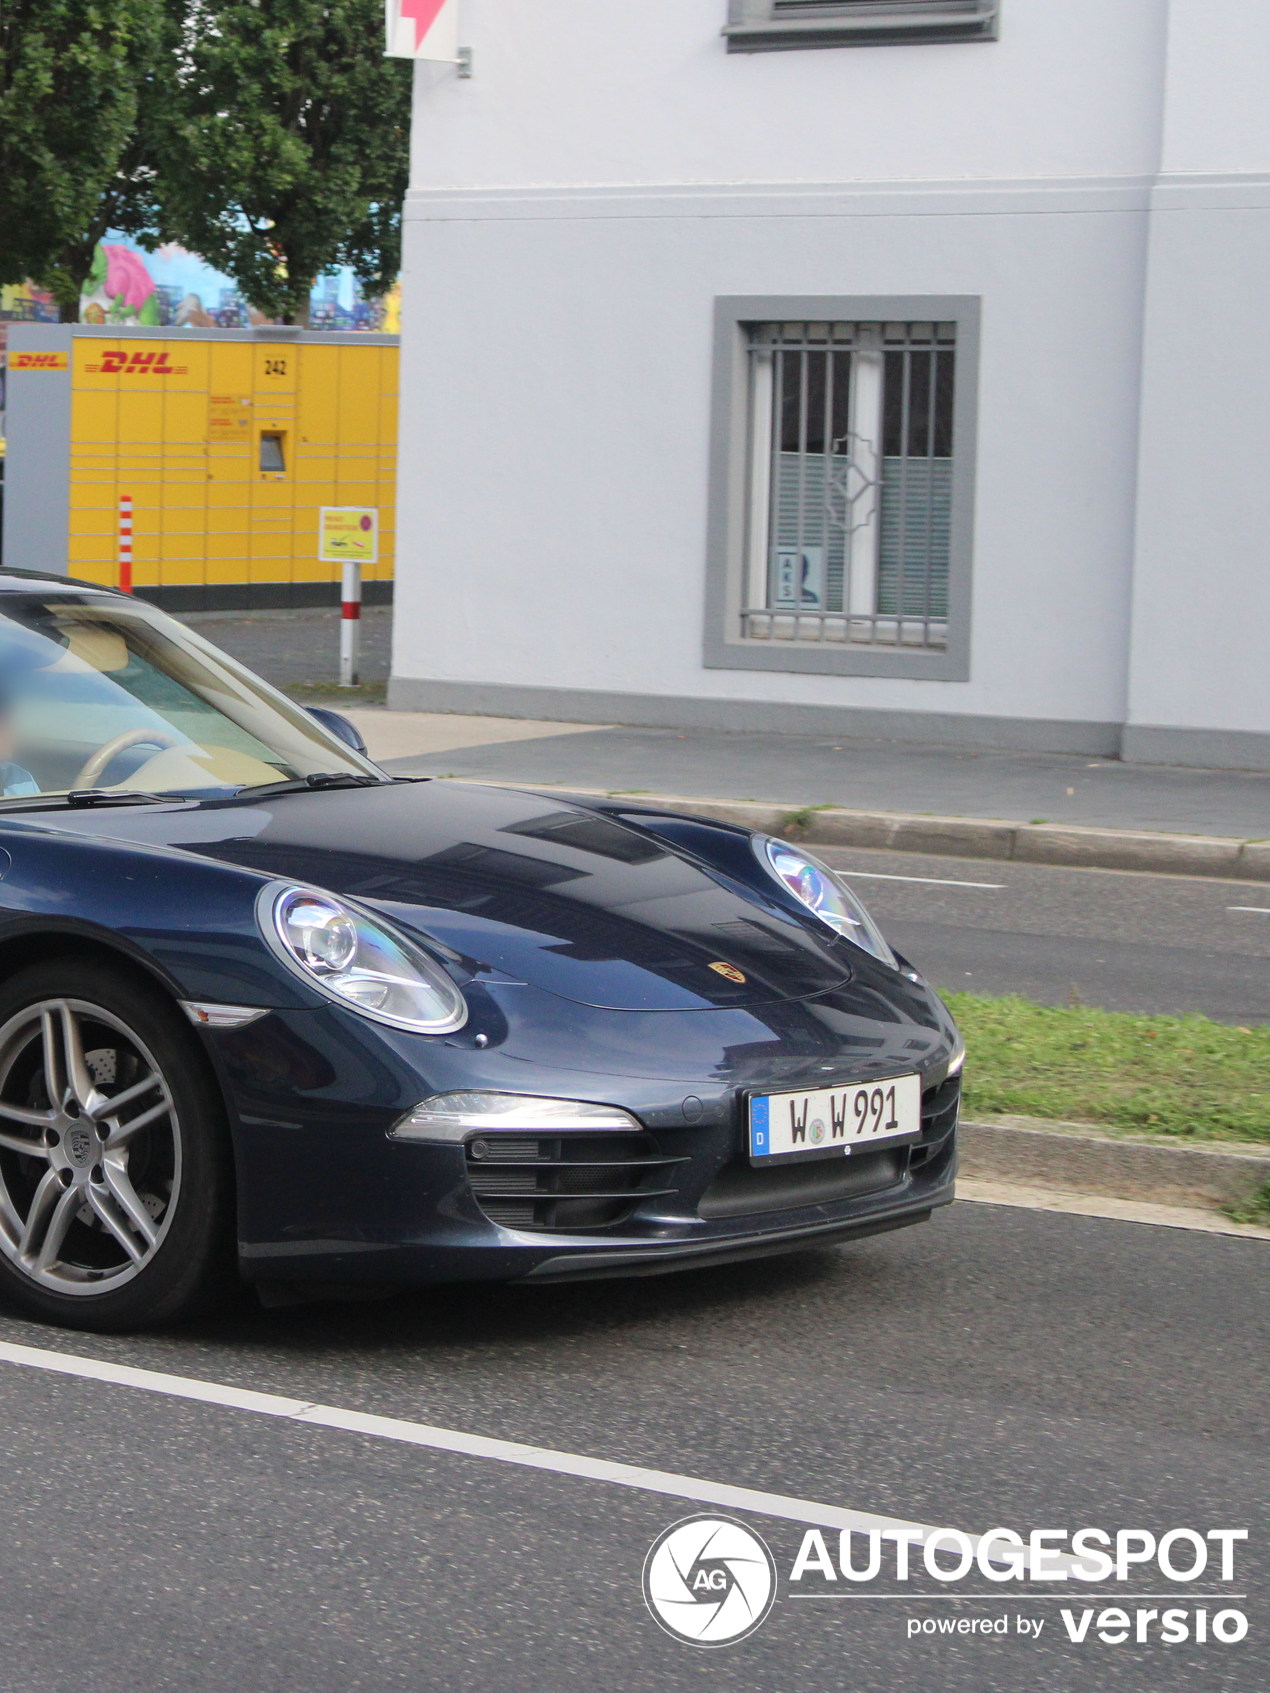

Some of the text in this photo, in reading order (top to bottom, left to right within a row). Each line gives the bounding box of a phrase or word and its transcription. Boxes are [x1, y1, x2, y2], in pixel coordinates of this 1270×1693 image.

[17, 355, 59, 367] DHL
[100, 351, 173, 374] DHL
[265, 360, 286, 375] 242
[790, 1098, 808, 1144] W
[756, 1132, 764, 1145] D
